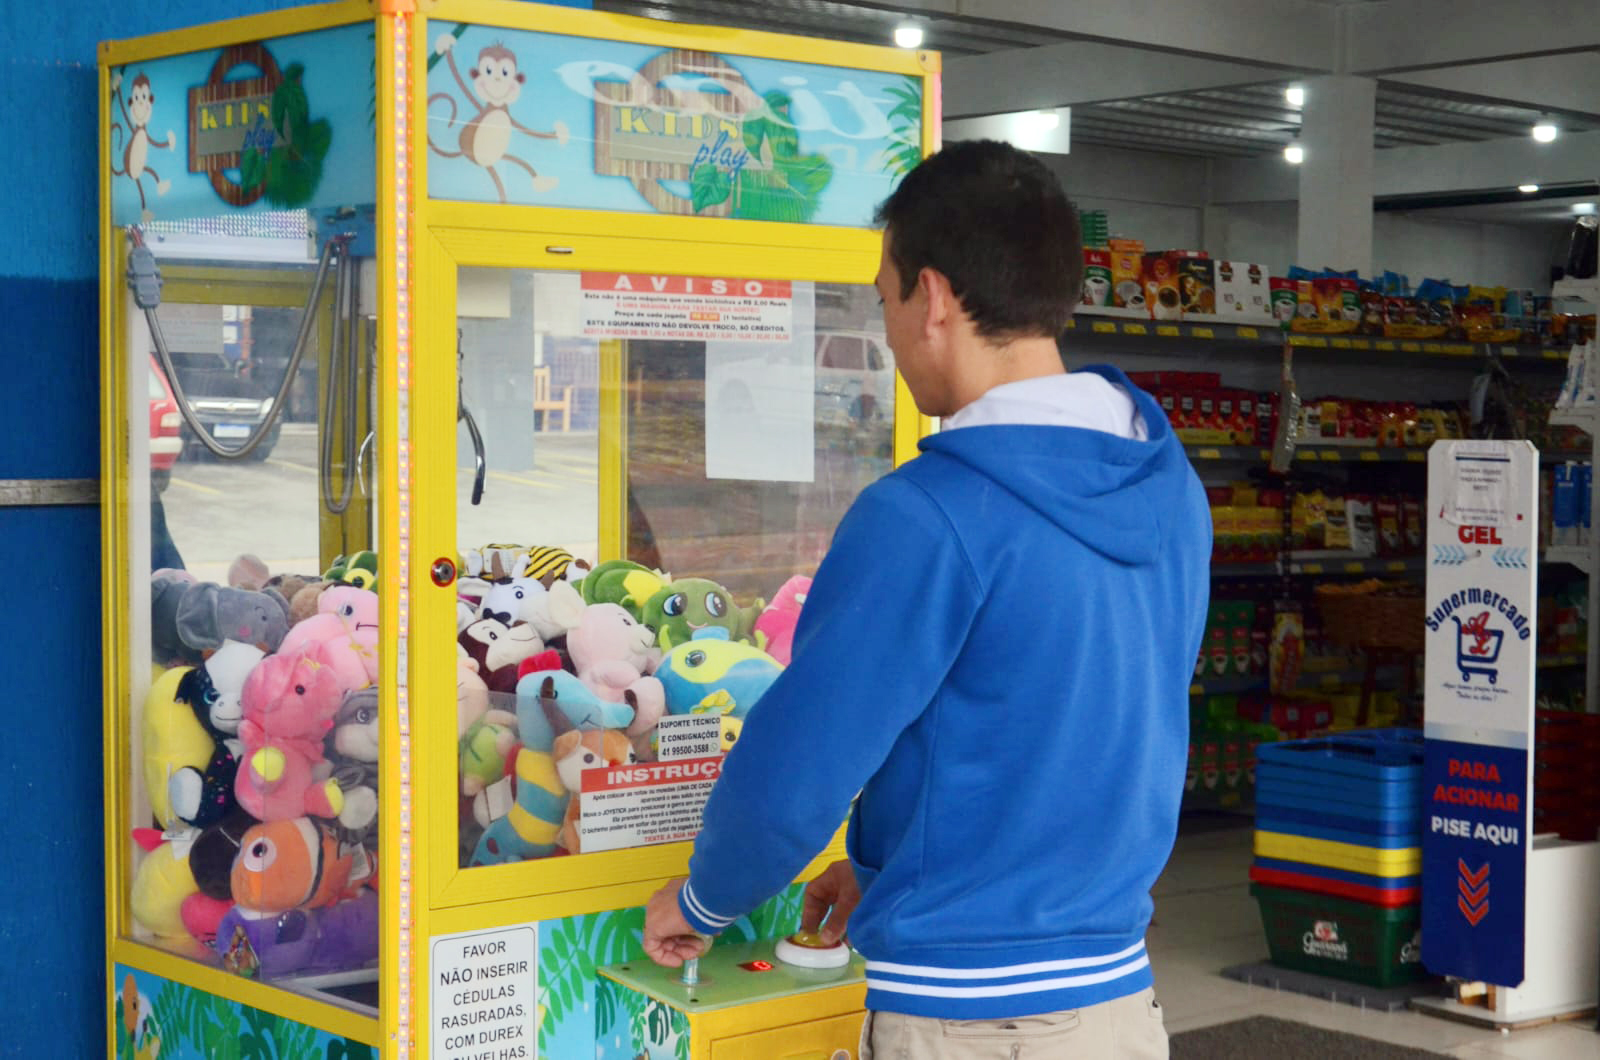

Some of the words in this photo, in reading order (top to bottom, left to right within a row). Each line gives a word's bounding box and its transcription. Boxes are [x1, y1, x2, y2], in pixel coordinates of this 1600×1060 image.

[614, 106, 739, 140] KIDS
[689, 131, 749, 185] play
[614, 274, 763, 295] AVISO
[607, 320, 660, 328] EQUIPAMENTO
[678, 322, 710, 330] DEVOLVE
[1457, 524, 1503, 545] GEL
[1424, 588, 1531, 641] Supermercado
[660, 719, 691, 729] SUPORTE
[692, 716, 721, 727] TÉCNICO
[661, 735, 667, 743] E
[668, 730, 719, 742] CONSIGNAÇÕES
[662, 747, 670, 756] 41
[671, 743, 709, 756] 99500-3588
[607, 762, 723, 785] INSTRUÇ
[1448, 758, 1502, 784] PARA
[1432, 783, 1520, 812] ACIONAR
[1431, 815, 1472, 838] PISE
[1474, 821, 1519, 846] AQUI
[463, 940, 507, 959] FAVOR
[440, 967, 473, 986] NÃO
[477, 960, 529, 980] INSERIR
[453, 984, 516, 1006] CÉDULAS
[445, 1033, 475, 1050] COM
[479, 1024, 524, 1045] DUREX
